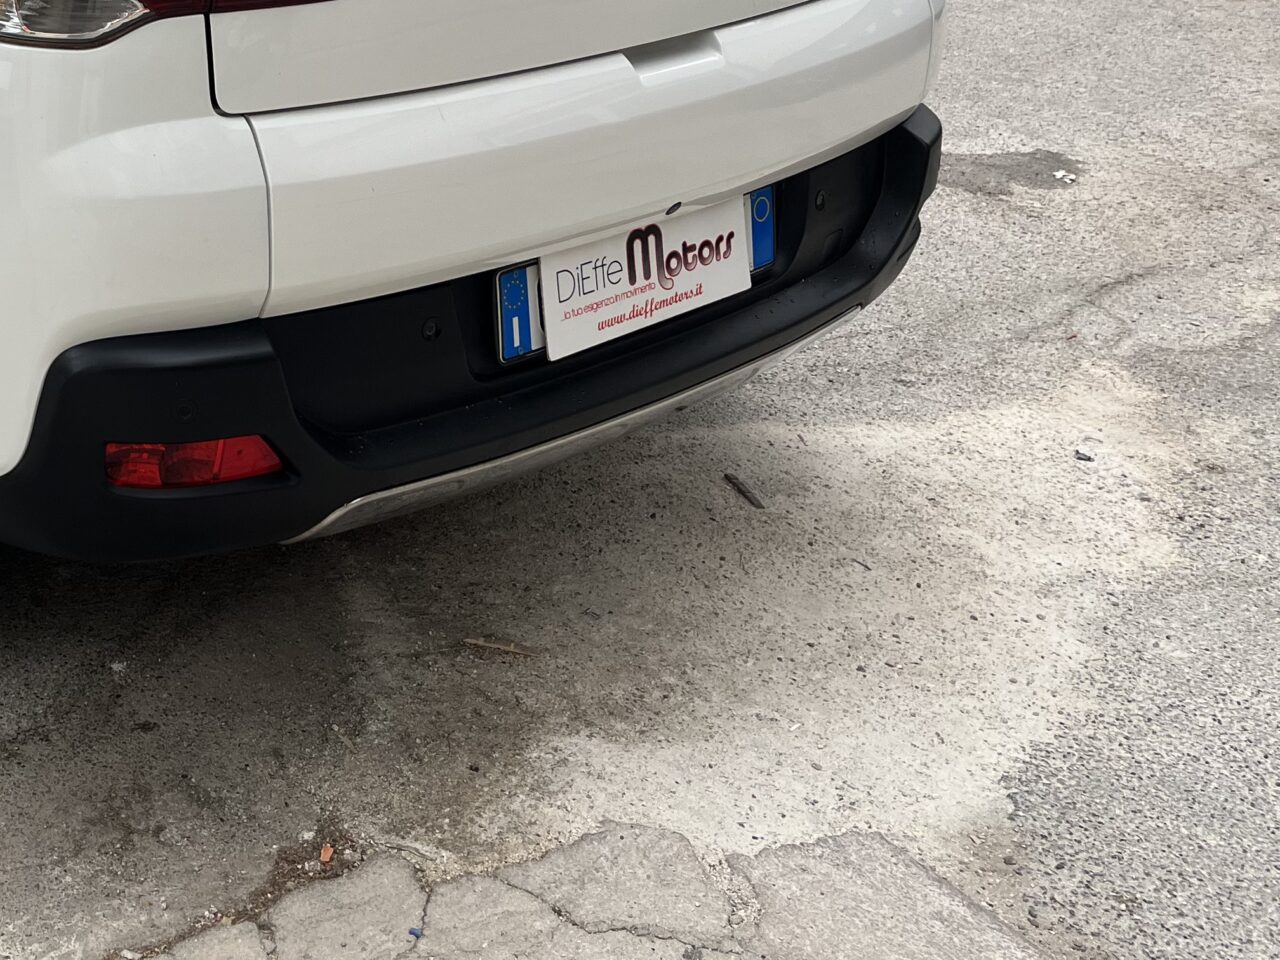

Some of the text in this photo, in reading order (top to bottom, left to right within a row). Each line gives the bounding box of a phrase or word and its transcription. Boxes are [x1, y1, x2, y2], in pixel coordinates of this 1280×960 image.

[555, 255, 624, 304] DiEffe
[584, 296, 615, 314] esigenza
[621, 282, 656, 301] movimento
[597, 282, 704, 332] www.dieffemotors.it
